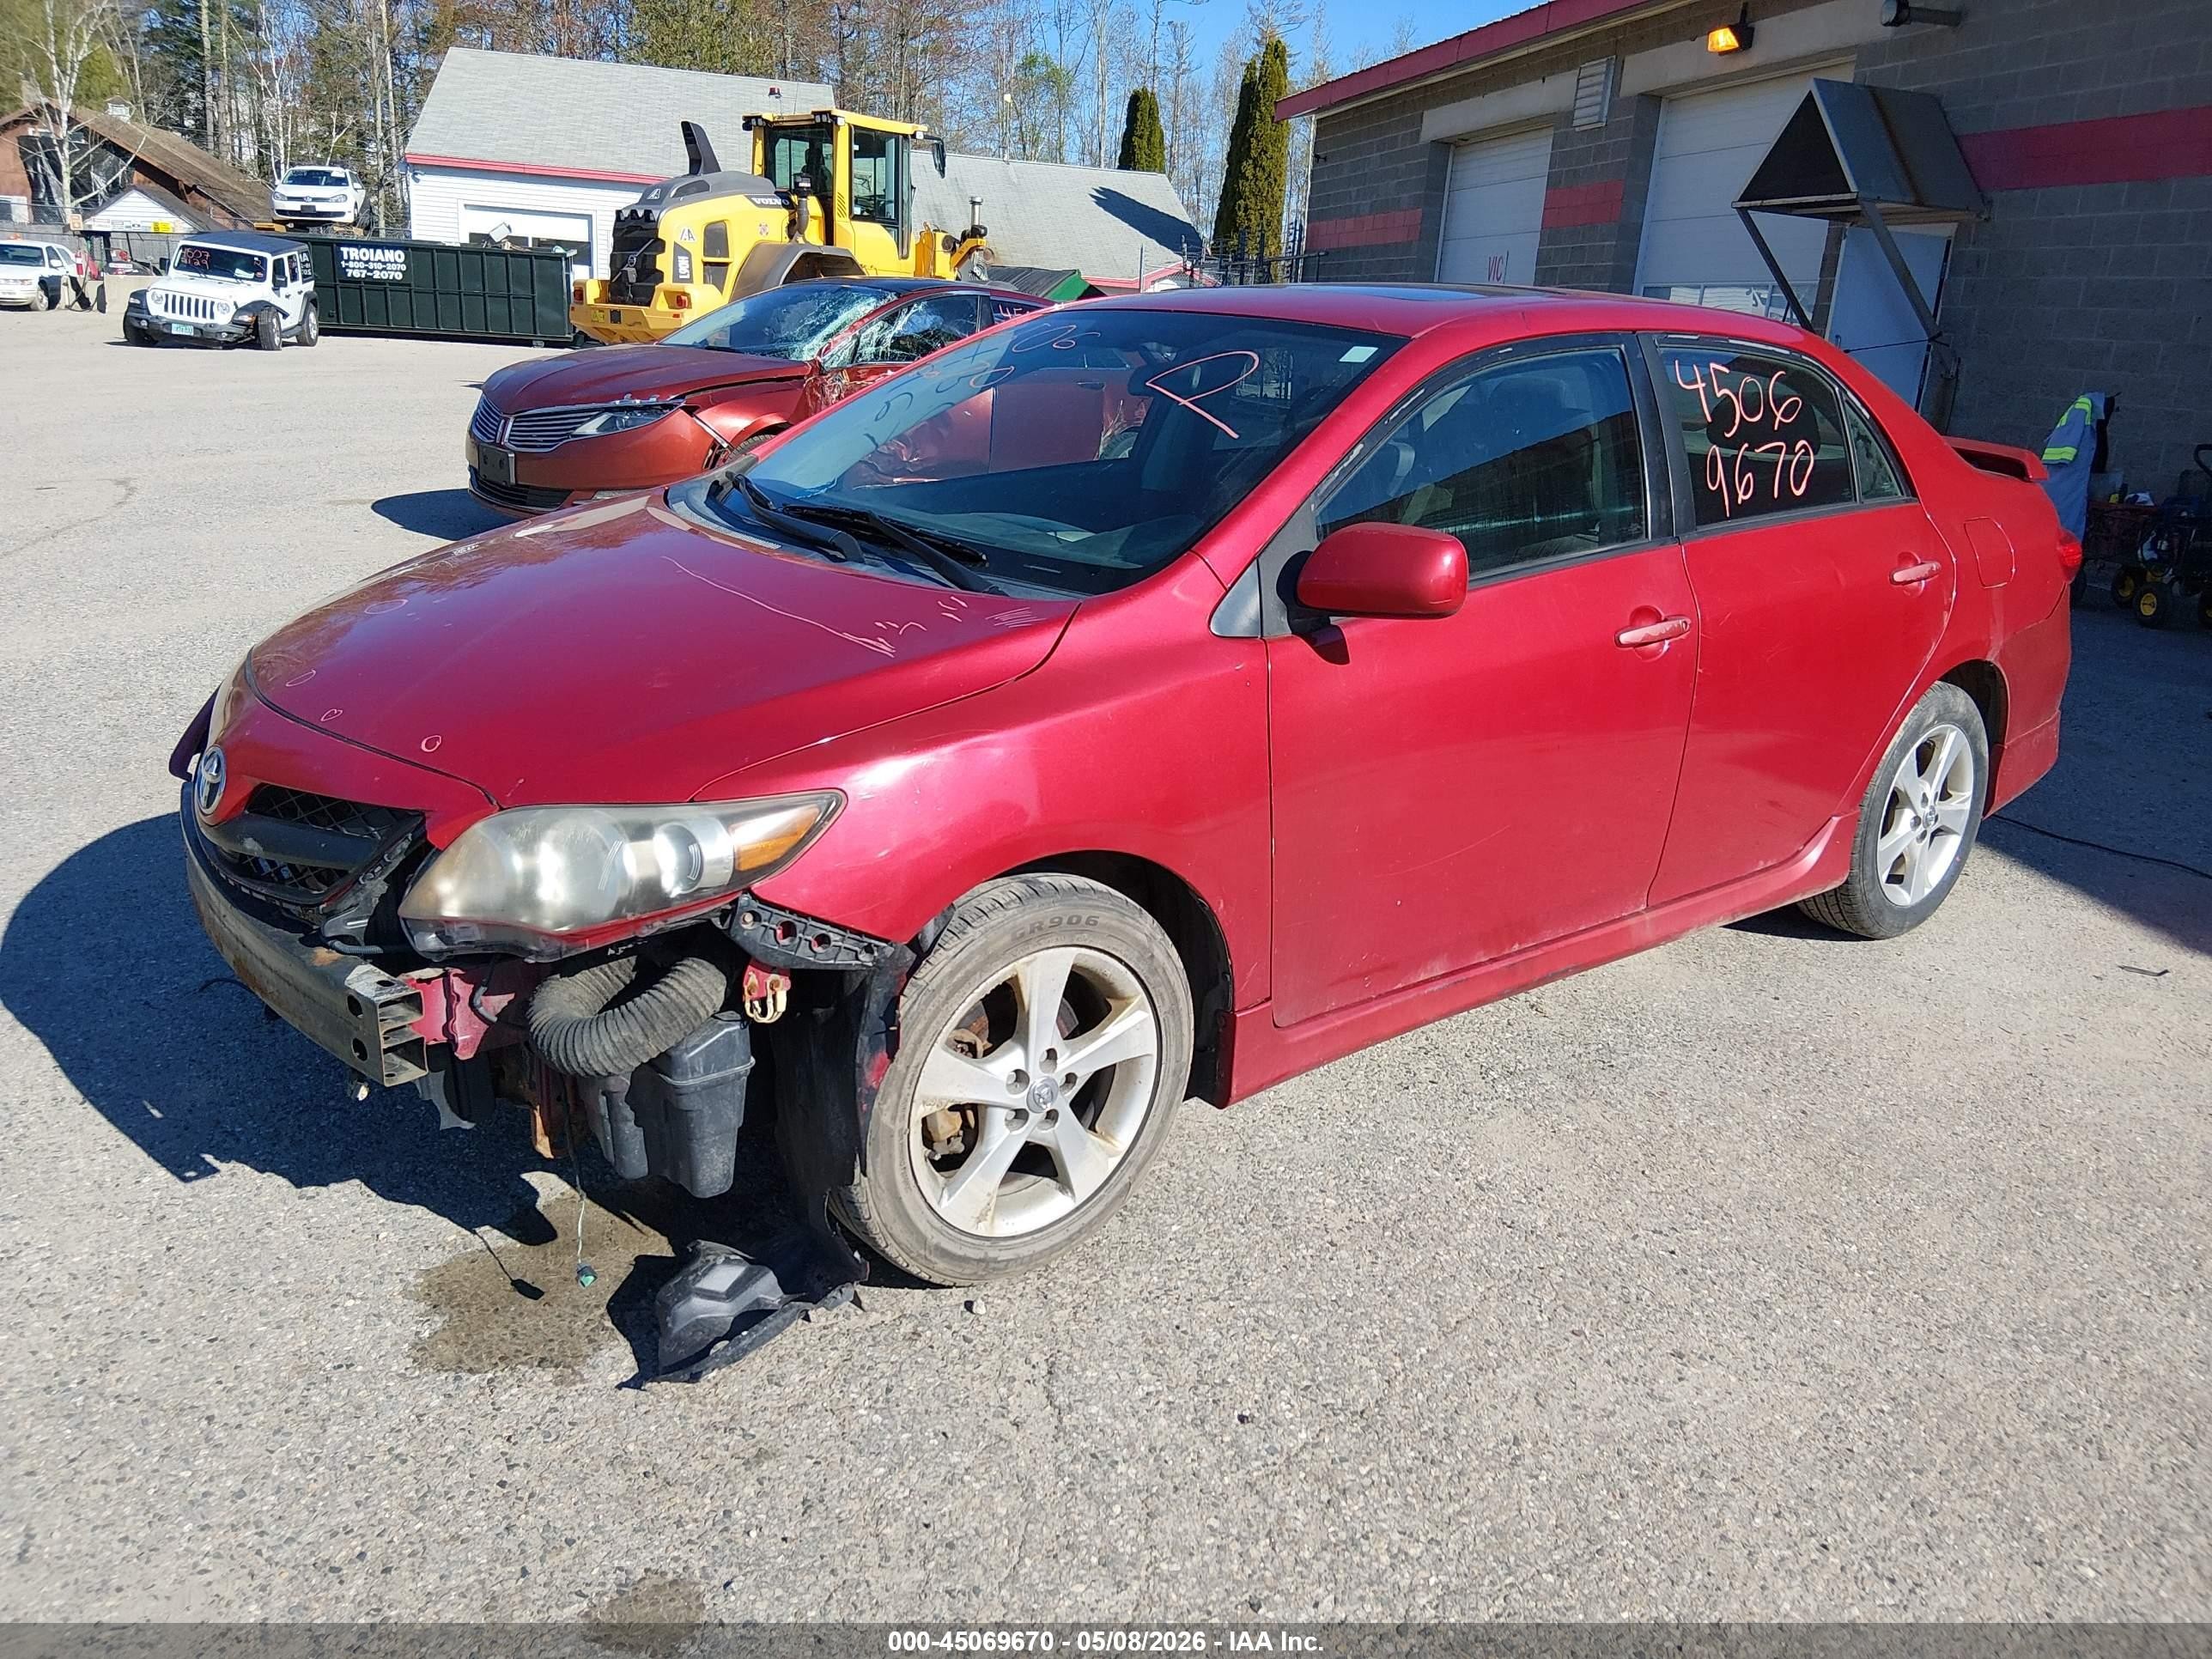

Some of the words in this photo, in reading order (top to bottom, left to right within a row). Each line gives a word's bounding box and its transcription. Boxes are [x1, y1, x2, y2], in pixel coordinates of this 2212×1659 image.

[750, 198, 790, 206] VOLVO
[340, 247, 405, 263] TROIANO
[340, 260, 407, 271] 1-800-310-2070
[345, 269, 404, 281] 767-2070
[1674, 359, 1802, 438] 4506
[1706, 440, 1814, 518] 9670
